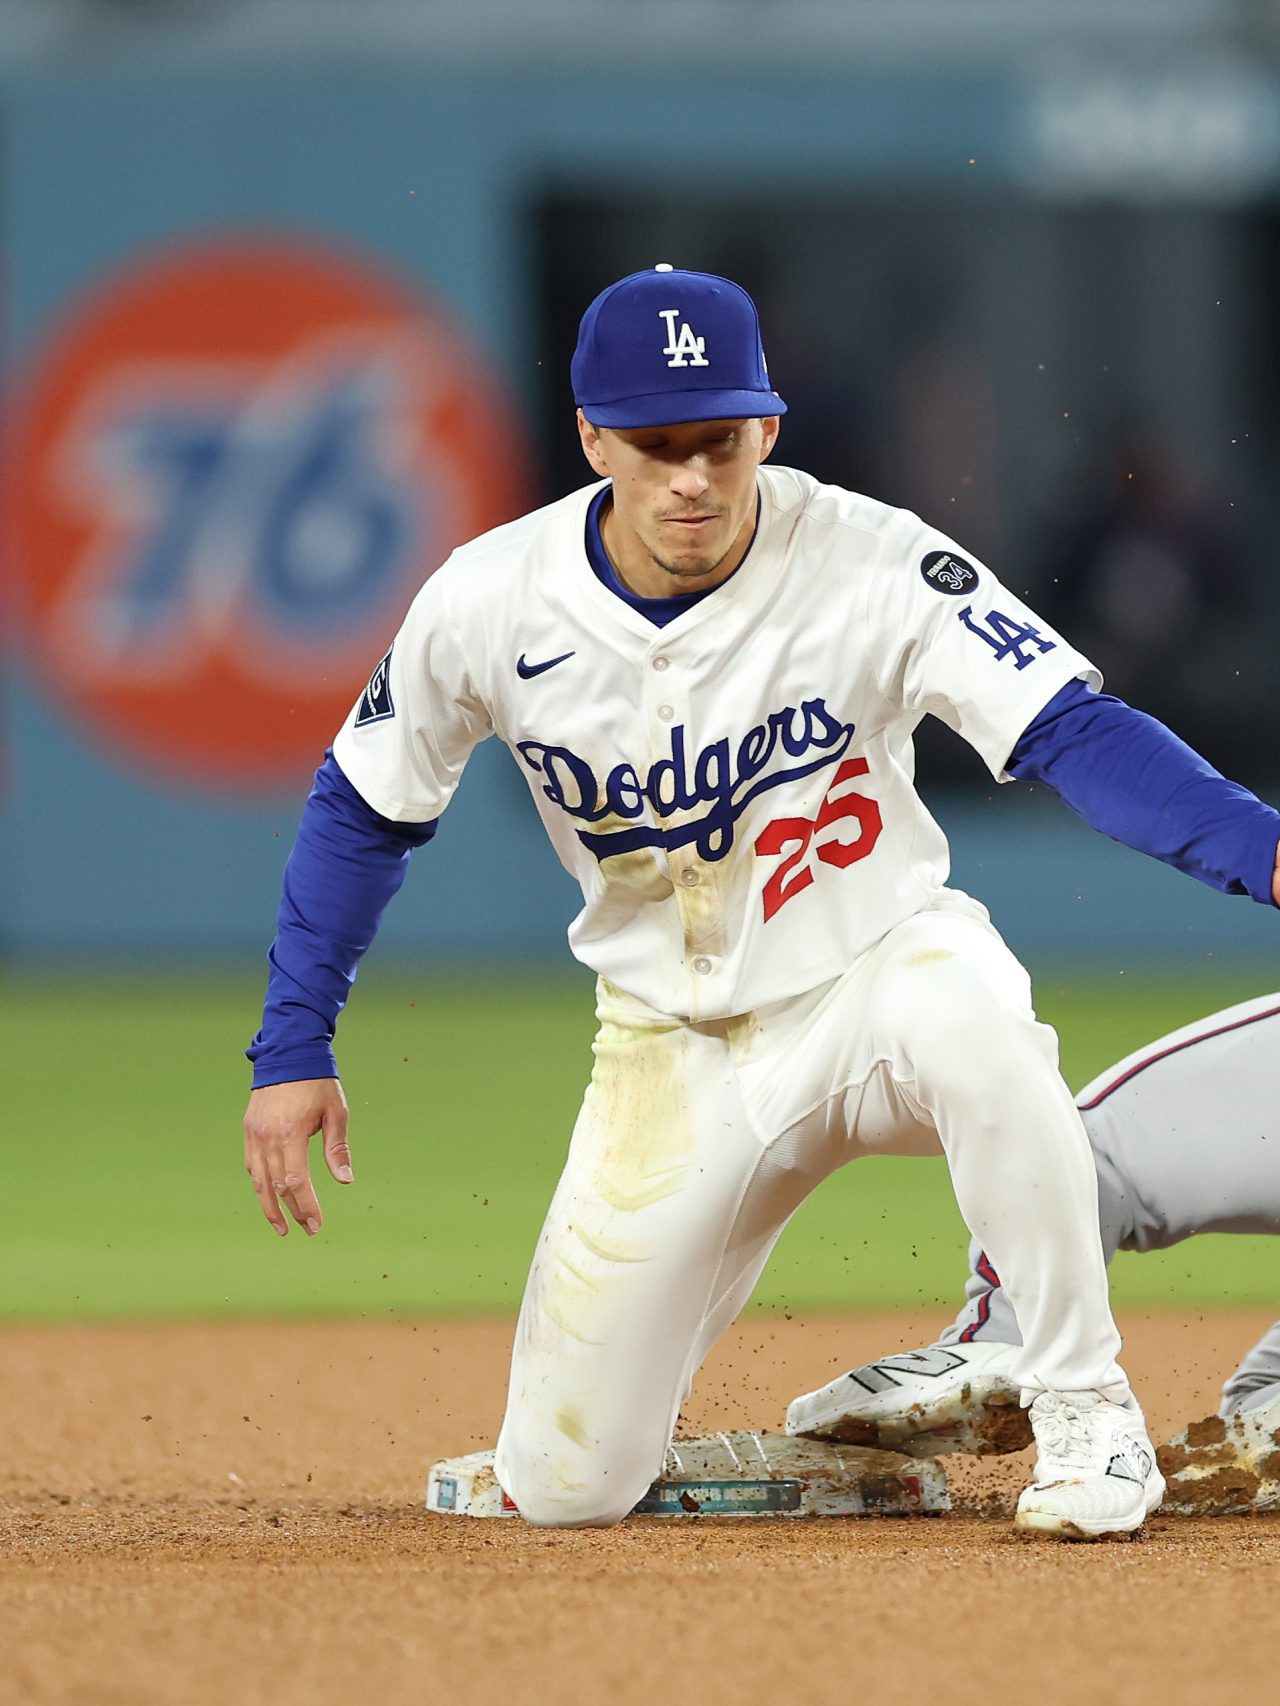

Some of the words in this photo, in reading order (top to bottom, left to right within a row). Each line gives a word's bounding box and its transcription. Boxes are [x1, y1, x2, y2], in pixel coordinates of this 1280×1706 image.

[658, 309, 709, 367] LA
[90, 342, 432, 658] 76
[937, 561, 973, 590] 34
[957, 605, 1057, 671] LA
[516, 697, 856, 862] Dodgers
[755, 757, 883, 924] 25
